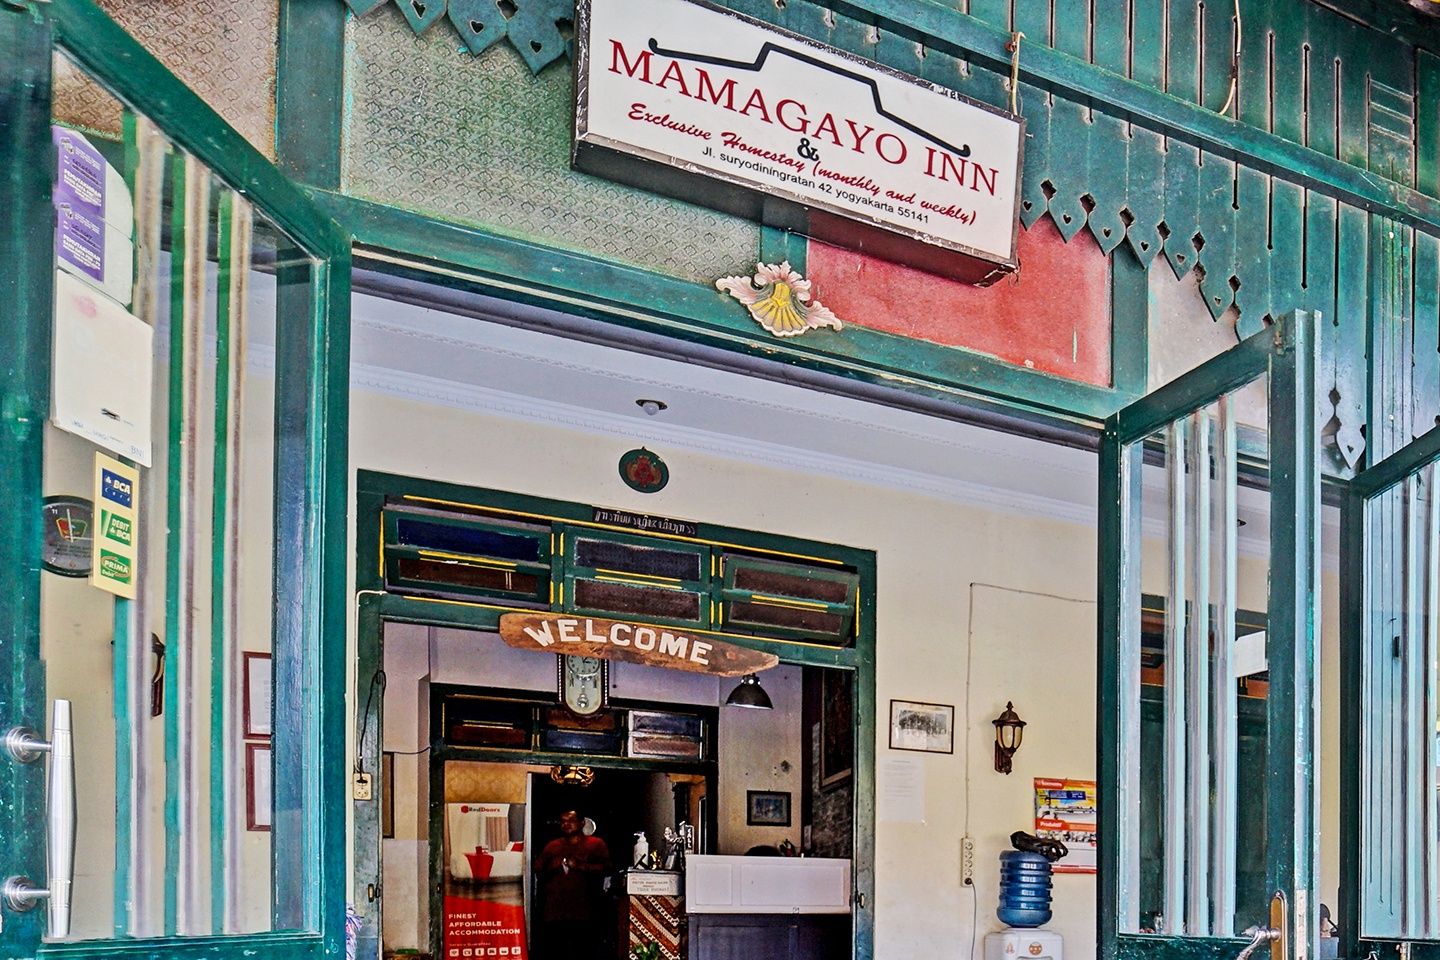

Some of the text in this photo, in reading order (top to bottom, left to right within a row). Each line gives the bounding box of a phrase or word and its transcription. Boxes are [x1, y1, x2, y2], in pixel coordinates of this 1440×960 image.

[608, 38, 999, 196] MAMAGAYO INN
[628, 103, 977, 226] Exclusive Homestay (monthly and weekly)
[797, 137, 820, 161] &
[702, 146, 717, 159] Jl.
[818, 182, 833, 194] 42
[835, 188, 894, 213] yogyakarta
[897, 206, 929, 224] 55141
[113, 479, 131, 494] BCA
[104, 560, 129, 574] PRIMA
[523, 619, 713, 665] WELCOME
[449, 928, 521, 936] ACCOMMODATION
